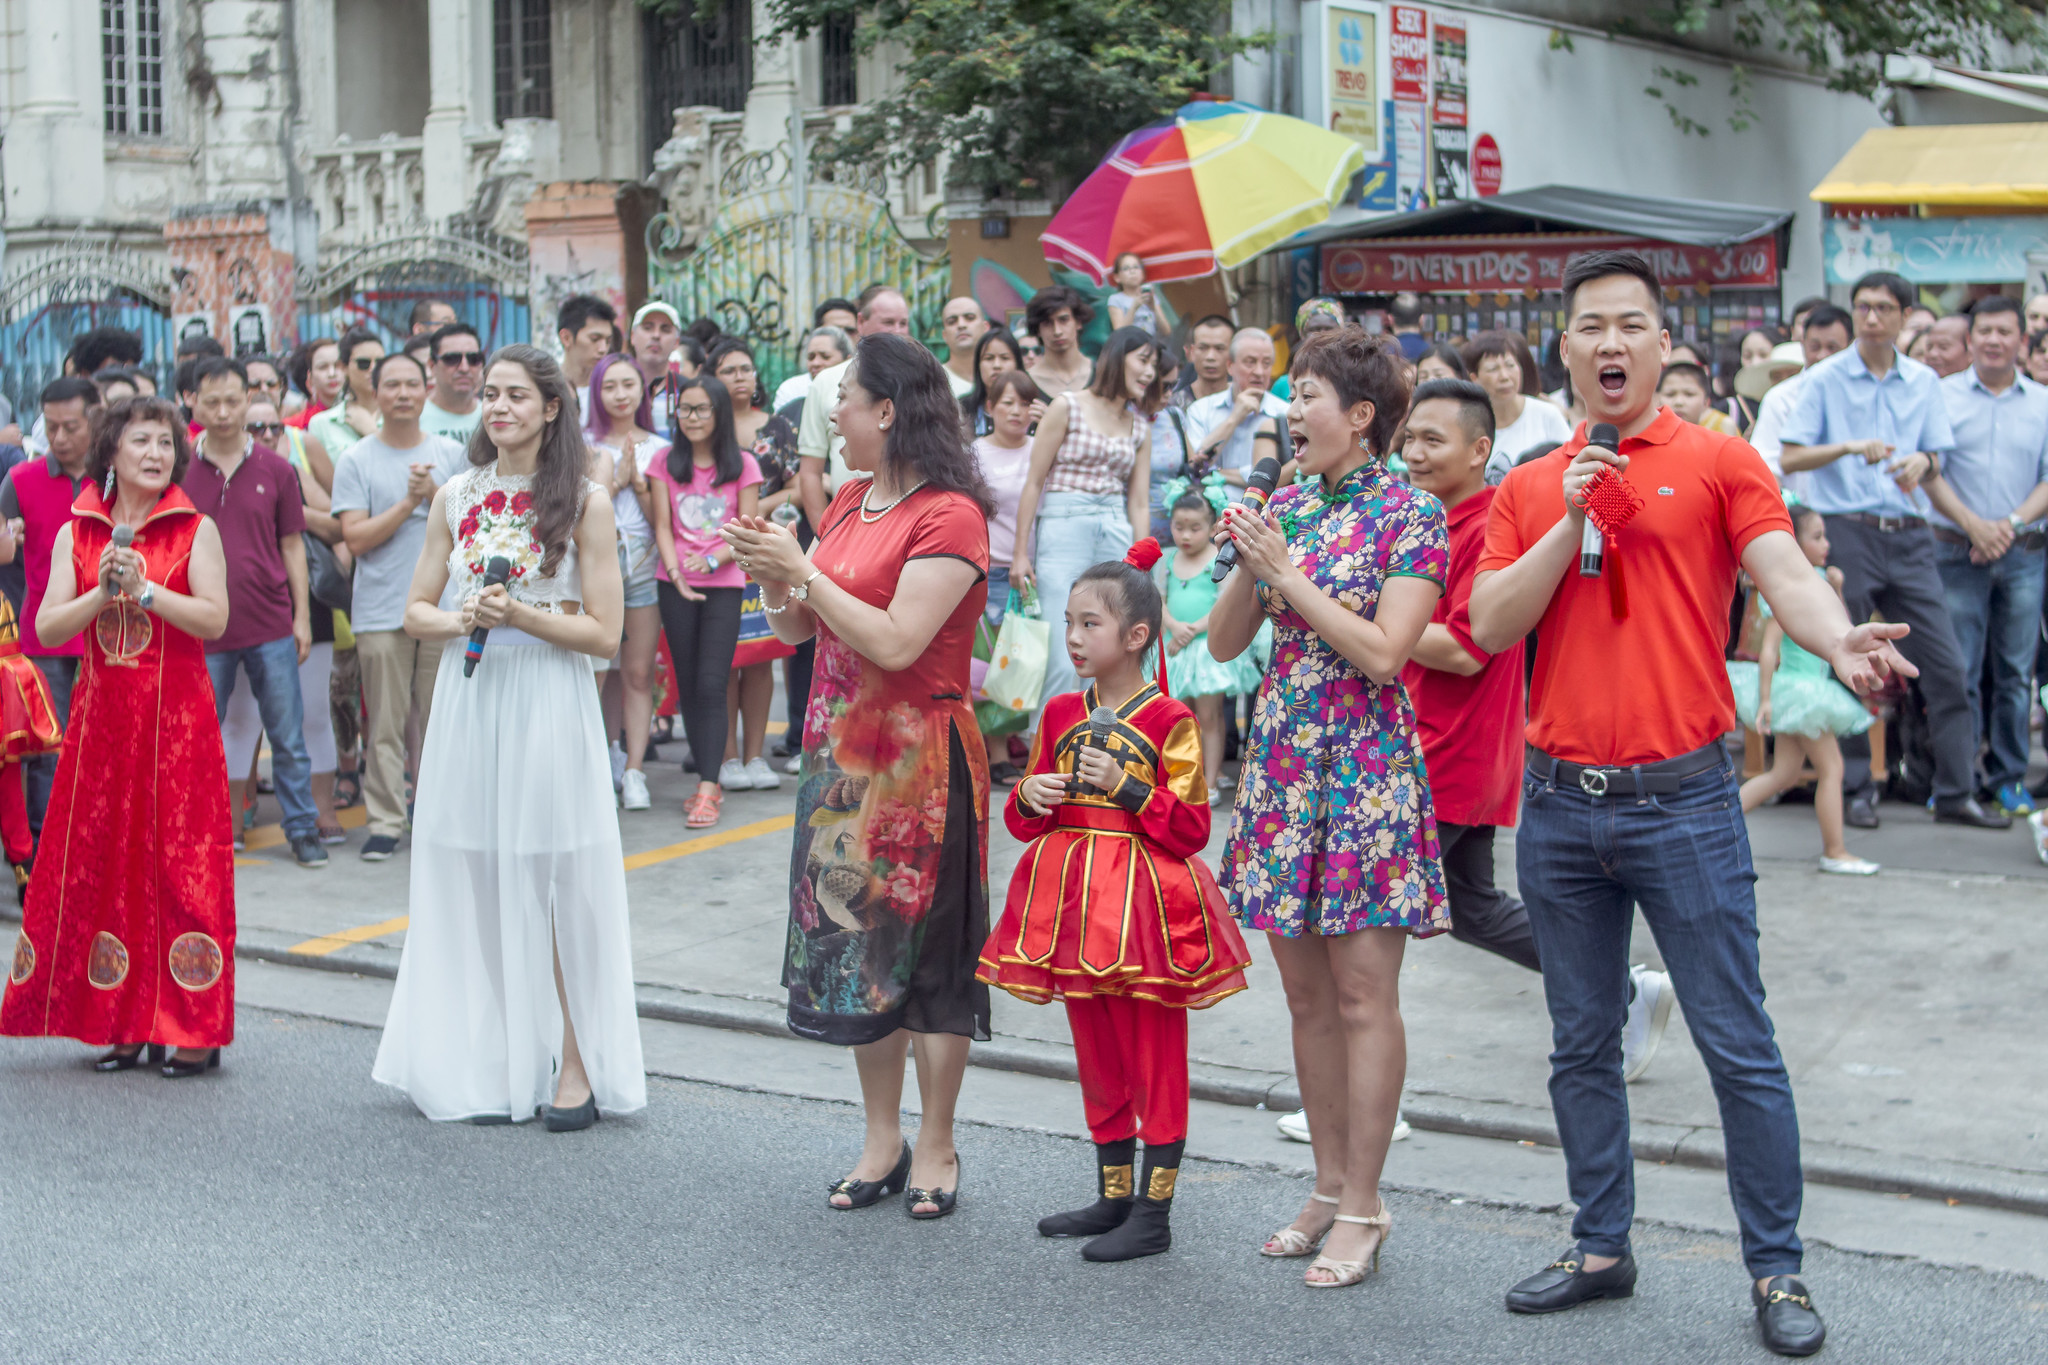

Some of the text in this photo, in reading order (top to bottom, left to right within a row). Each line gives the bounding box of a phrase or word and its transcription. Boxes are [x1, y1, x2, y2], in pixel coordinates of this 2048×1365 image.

[1396, 8, 1424, 35] SEX
[1391, 34, 1427, 59] SHOP
[1334, 69, 1367, 91] TREVO
[1389, 251, 1531, 284] DIVERTIDOS
[1538, 256, 1558, 279] DE
[1713, 247, 1767, 280] 3.00
